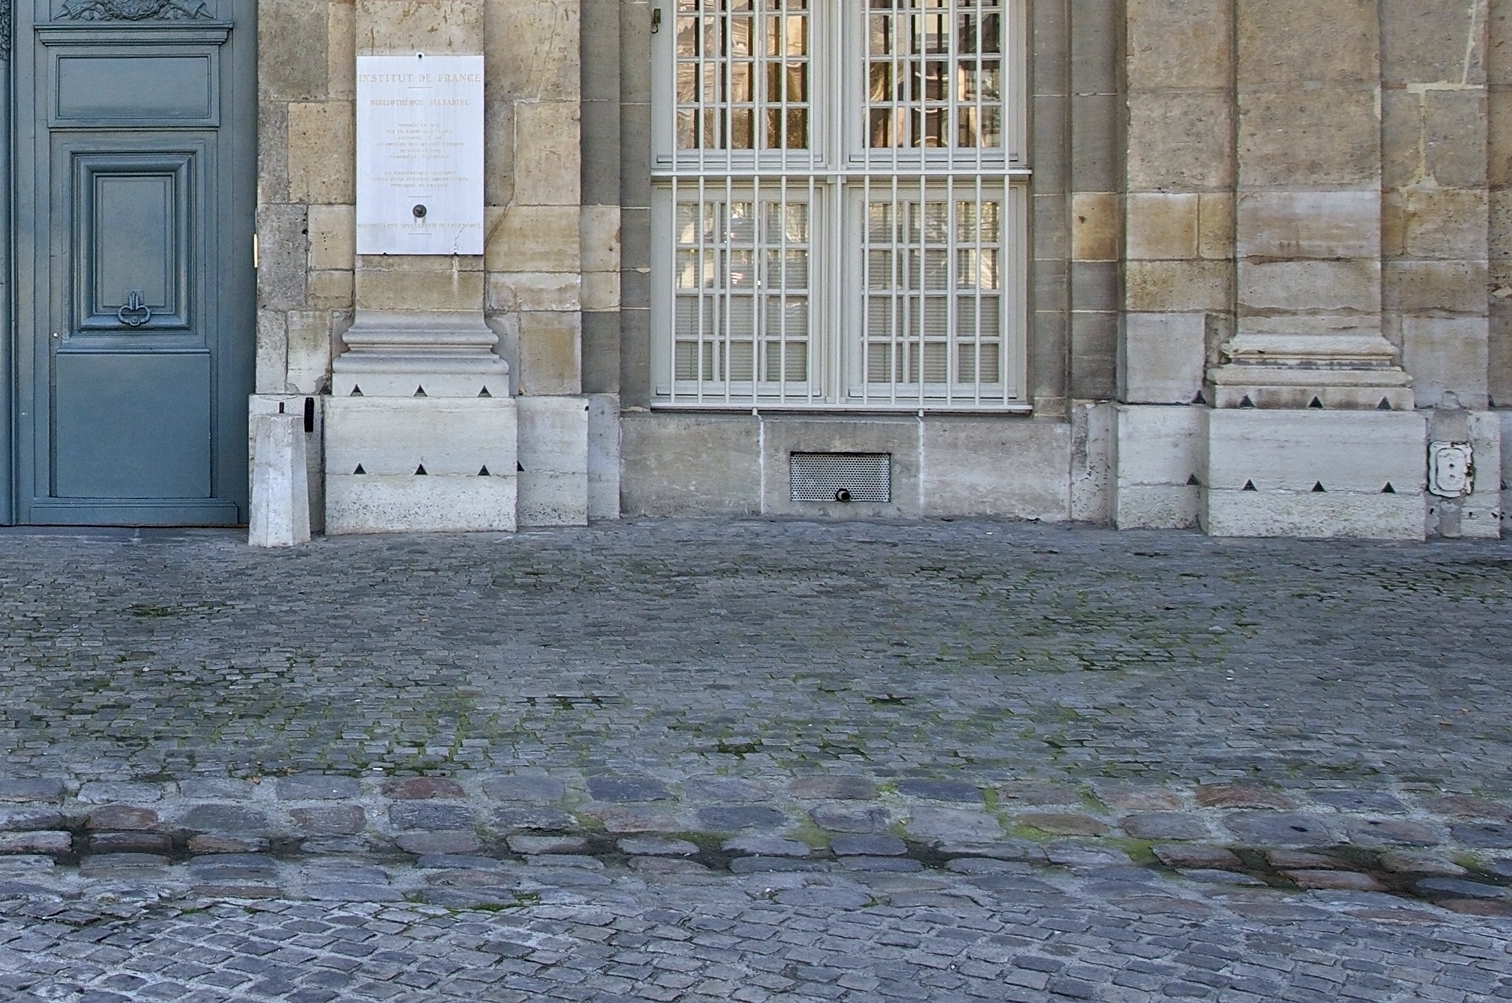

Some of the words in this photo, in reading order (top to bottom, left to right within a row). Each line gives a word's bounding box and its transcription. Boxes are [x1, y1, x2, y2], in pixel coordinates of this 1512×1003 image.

[358, 73, 414, 83] INSTITUT
[418, 73, 432, 83] DE
[437, 73, 481, 83] FRANCE
